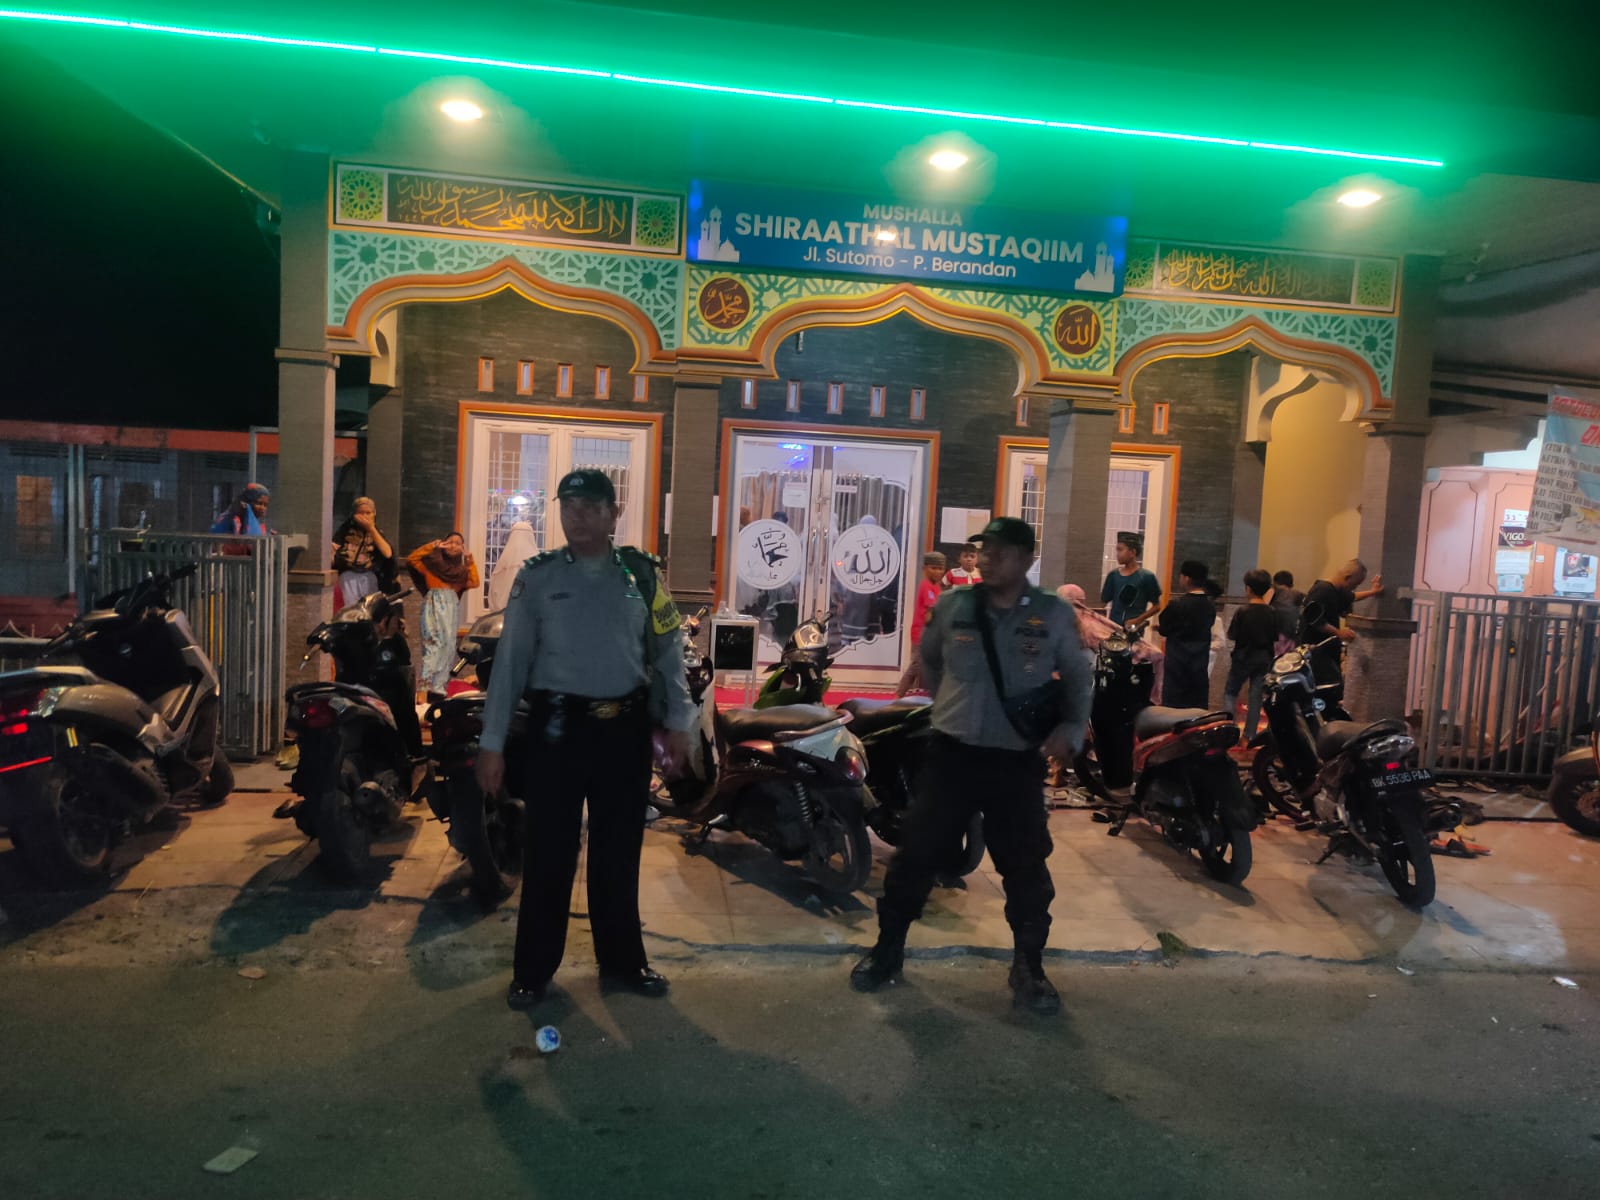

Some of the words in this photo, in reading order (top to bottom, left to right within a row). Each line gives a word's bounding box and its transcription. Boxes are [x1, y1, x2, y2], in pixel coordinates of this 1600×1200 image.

[863, 203, 963, 227] MUSHALLA
[735, 212, 916, 250] SHIRAATHAL
[922, 228, 1084, 264] MUSTAQIIM
[803, 246, 821, 262] Jl.
[825, 248, 895, 268] Sutomo
[913, 255, 928, 271] P.
[932, 257, 1017, 278] Berandan
